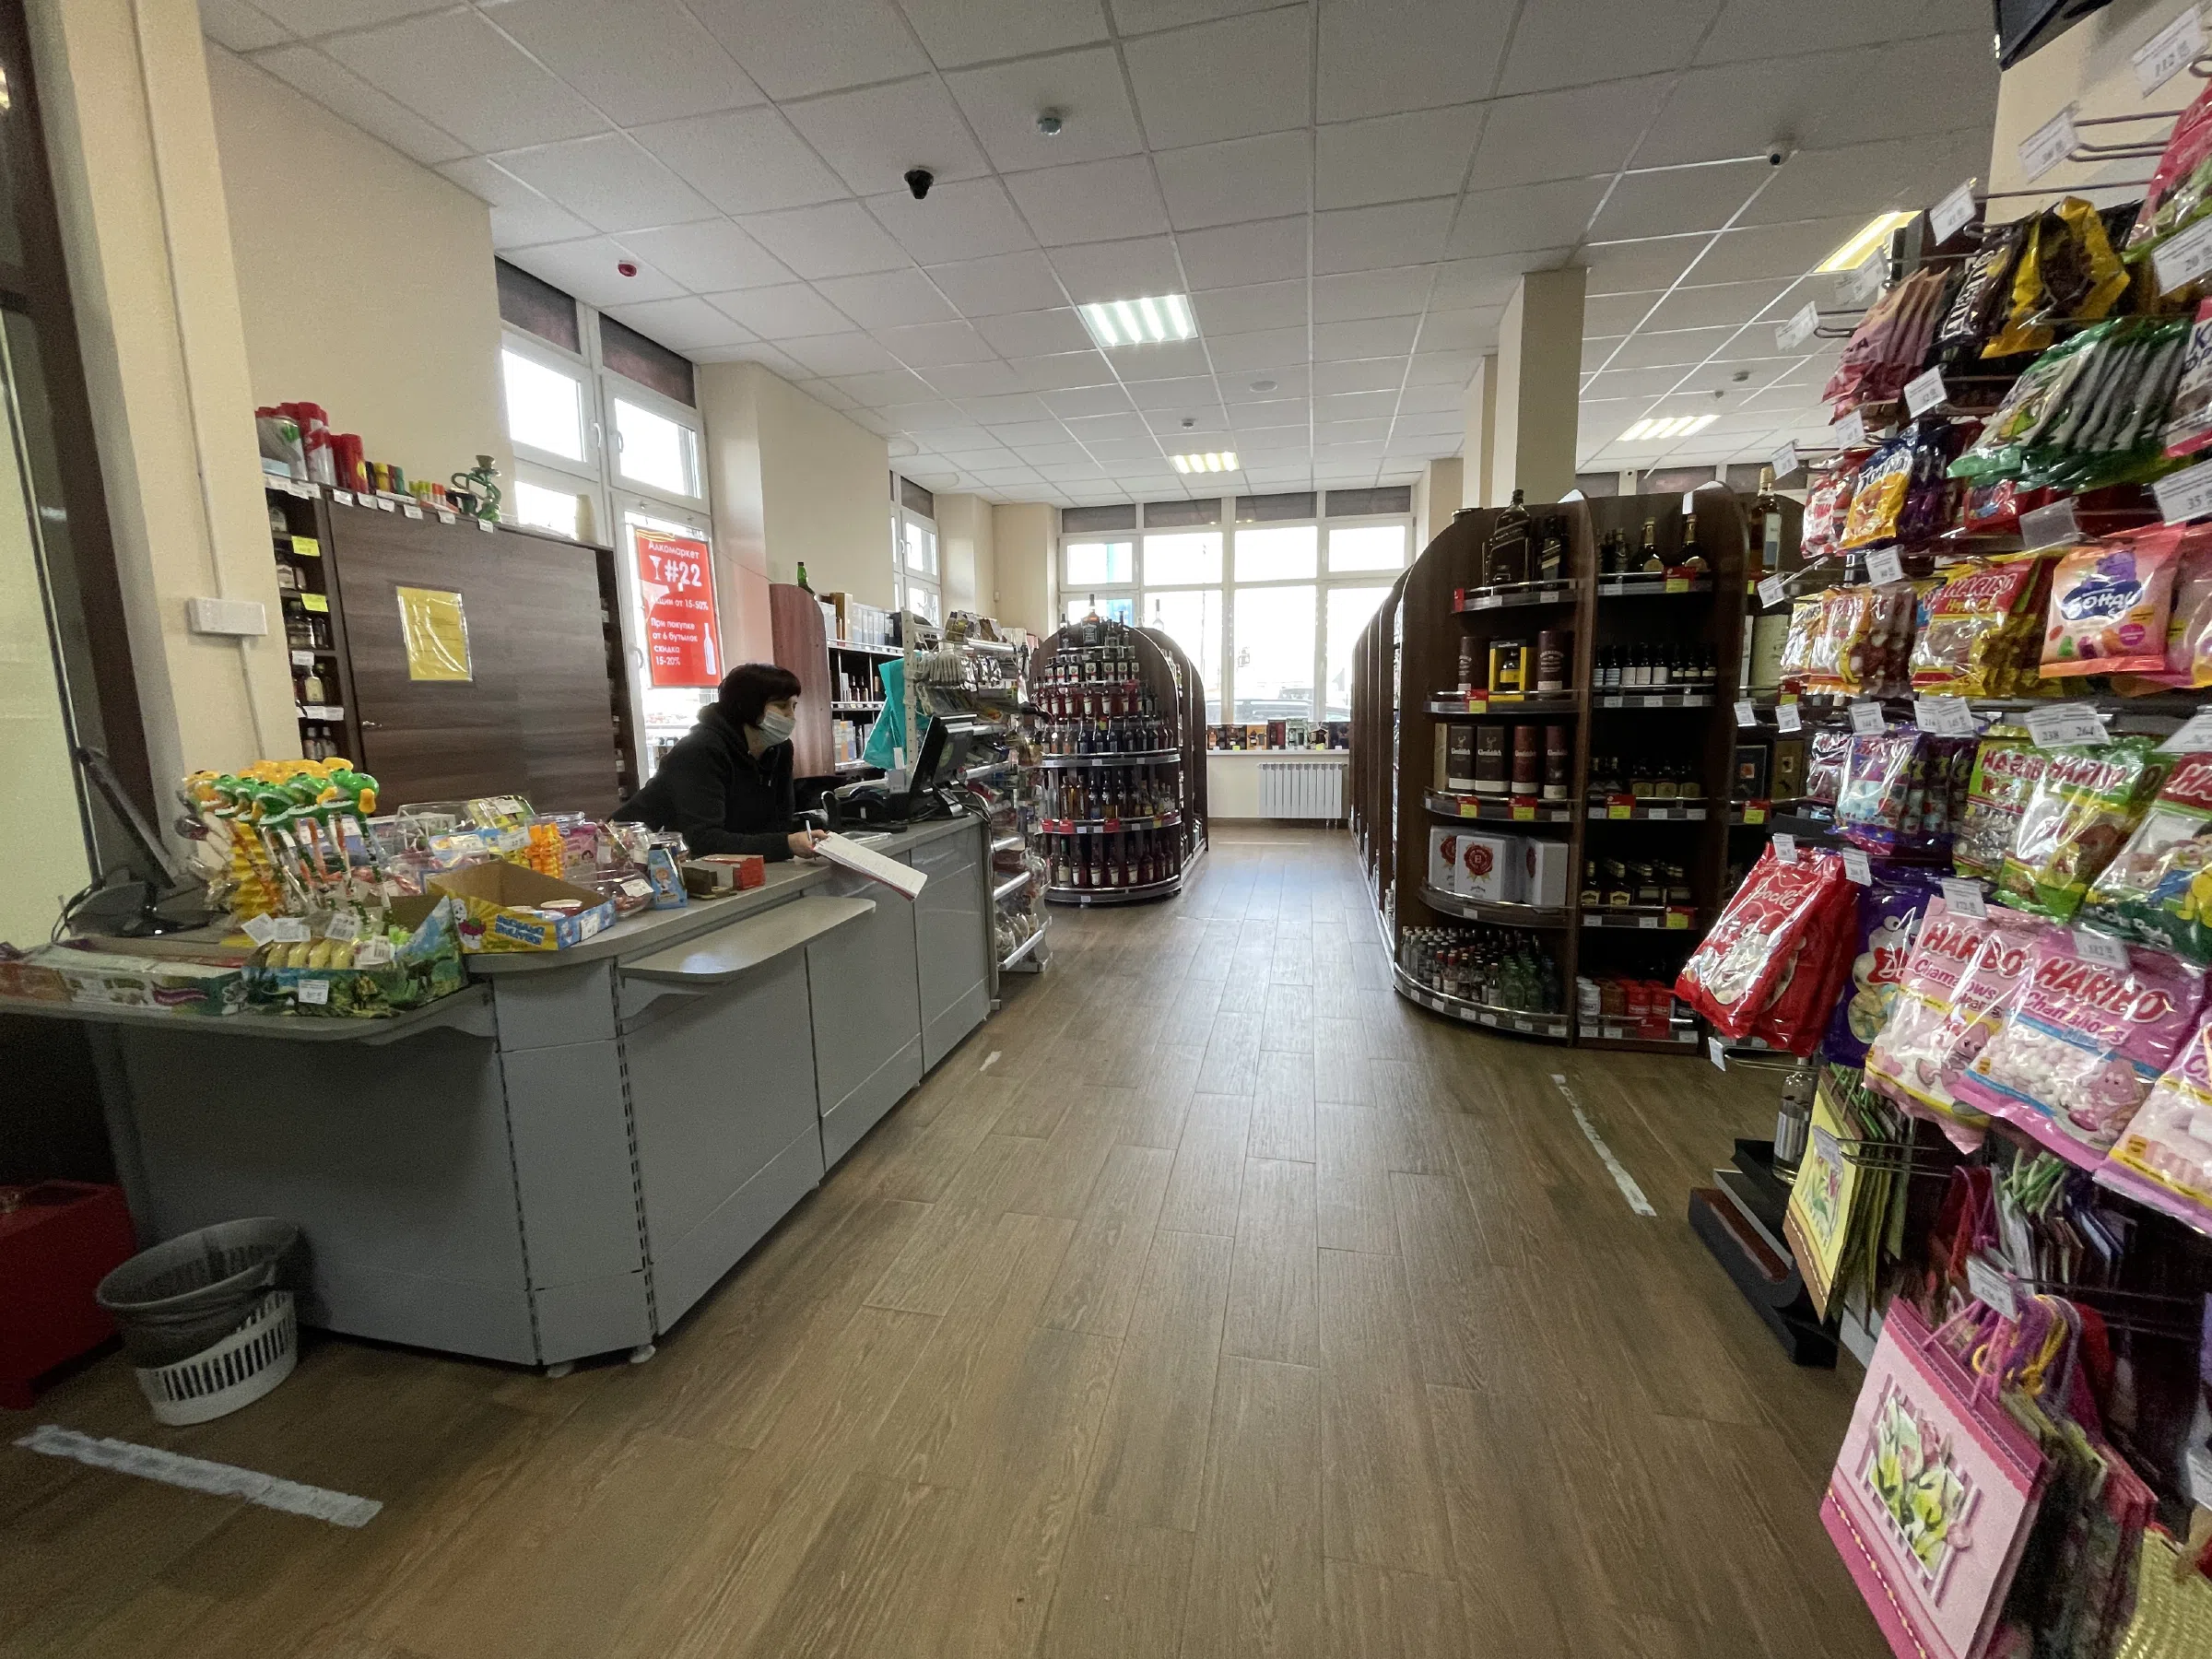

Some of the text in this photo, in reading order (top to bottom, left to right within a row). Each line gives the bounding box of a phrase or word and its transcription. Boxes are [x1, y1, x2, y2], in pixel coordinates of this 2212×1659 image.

[648, 540, 700, 559] Алкомаркет
[664, 559, 702, 587] #22
[650, 595, 674, 606] кции
[651, 618, 695, 630] При покупке
[668, 631, 698, 642] бутылок
[653, 645, 680, 653] скидка
[655, 655, 681, 665] 15-20%
[2041, 731, 2060, 742] 238
[2077, 726, 2094, 736] 264
[1982, 749, 2047, 782] HARIB
[1922, 923, 2029, 979] HARBO
[1914, 959, 1999, 1001] Chamaows
[2034, 958, 2171, 1023] HARIBO
